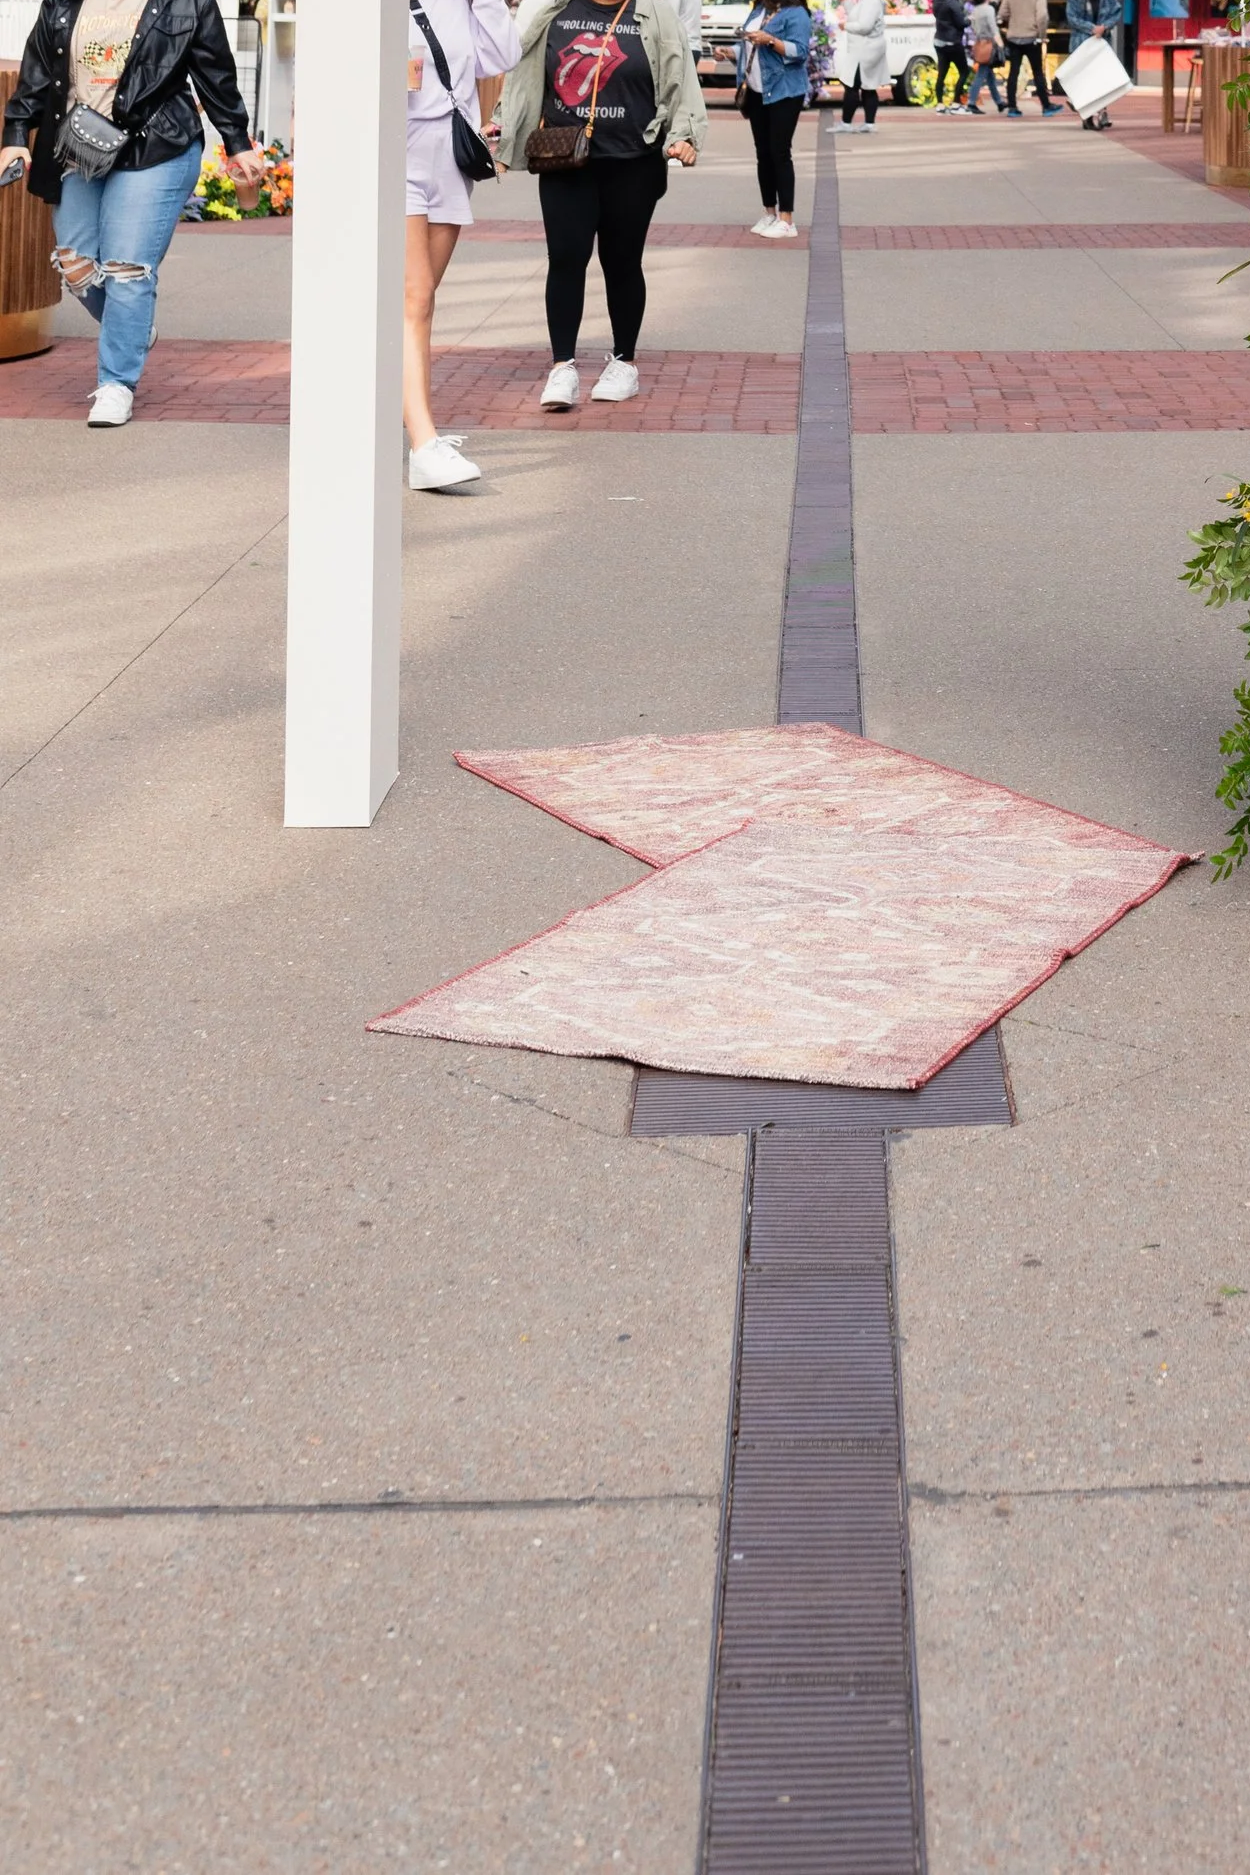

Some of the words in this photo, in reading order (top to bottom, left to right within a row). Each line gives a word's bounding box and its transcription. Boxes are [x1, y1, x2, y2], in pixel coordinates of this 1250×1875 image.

[563, 19, 603, 31] ROLLING
[604, 23, 641, 35] SONES
[596, 106, 626, 118] TOUR
